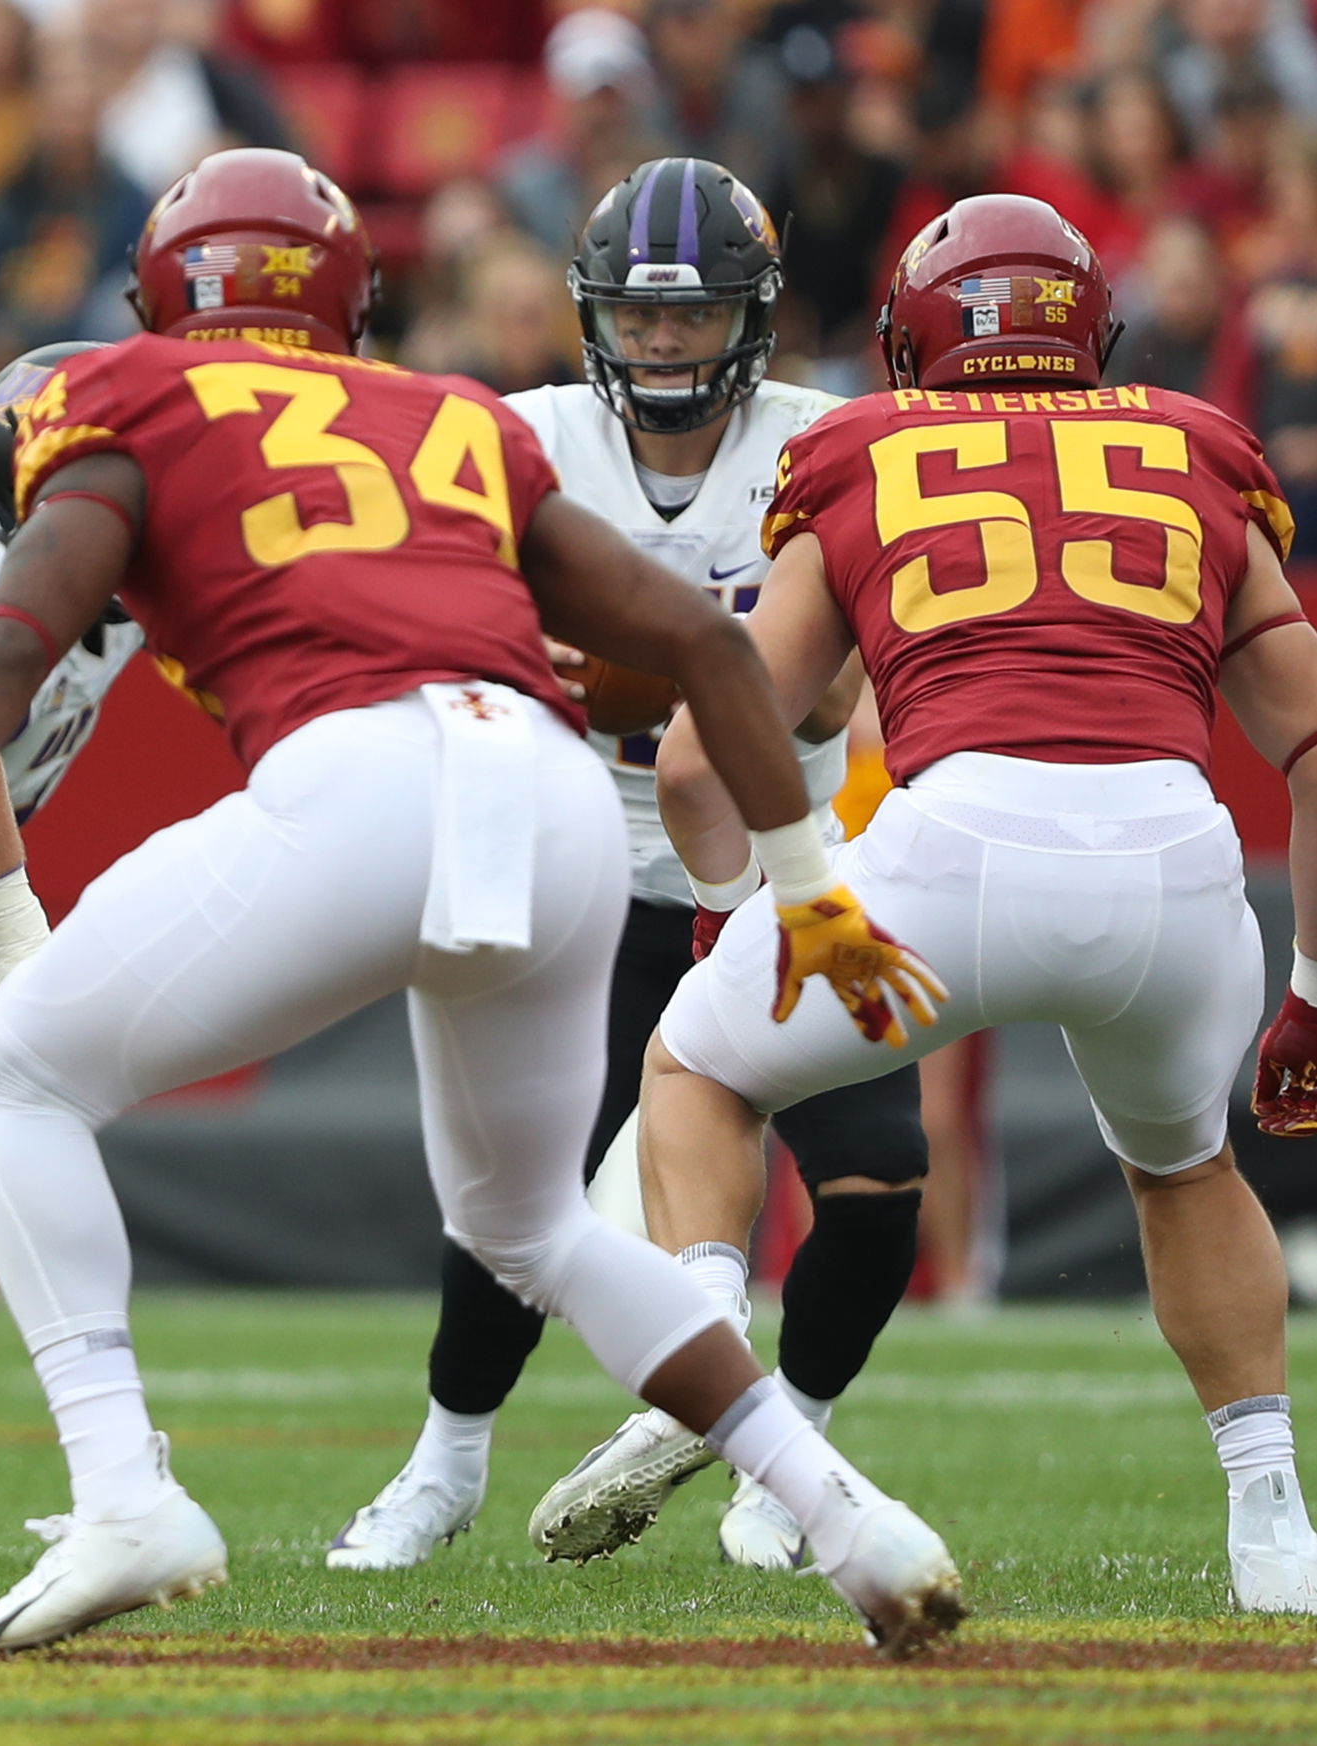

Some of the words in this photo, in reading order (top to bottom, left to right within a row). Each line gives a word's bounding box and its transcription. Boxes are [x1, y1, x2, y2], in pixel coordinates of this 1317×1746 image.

[273, 276, 301, 297] 34
[647, 269, 679, 282] UNI
[1045, 306, 1067, 323] 55
[892, 386, 1150, 413] PETERSEN
[185, 361, 522, 569] 34
[868, 420, 1203, 633] 55
